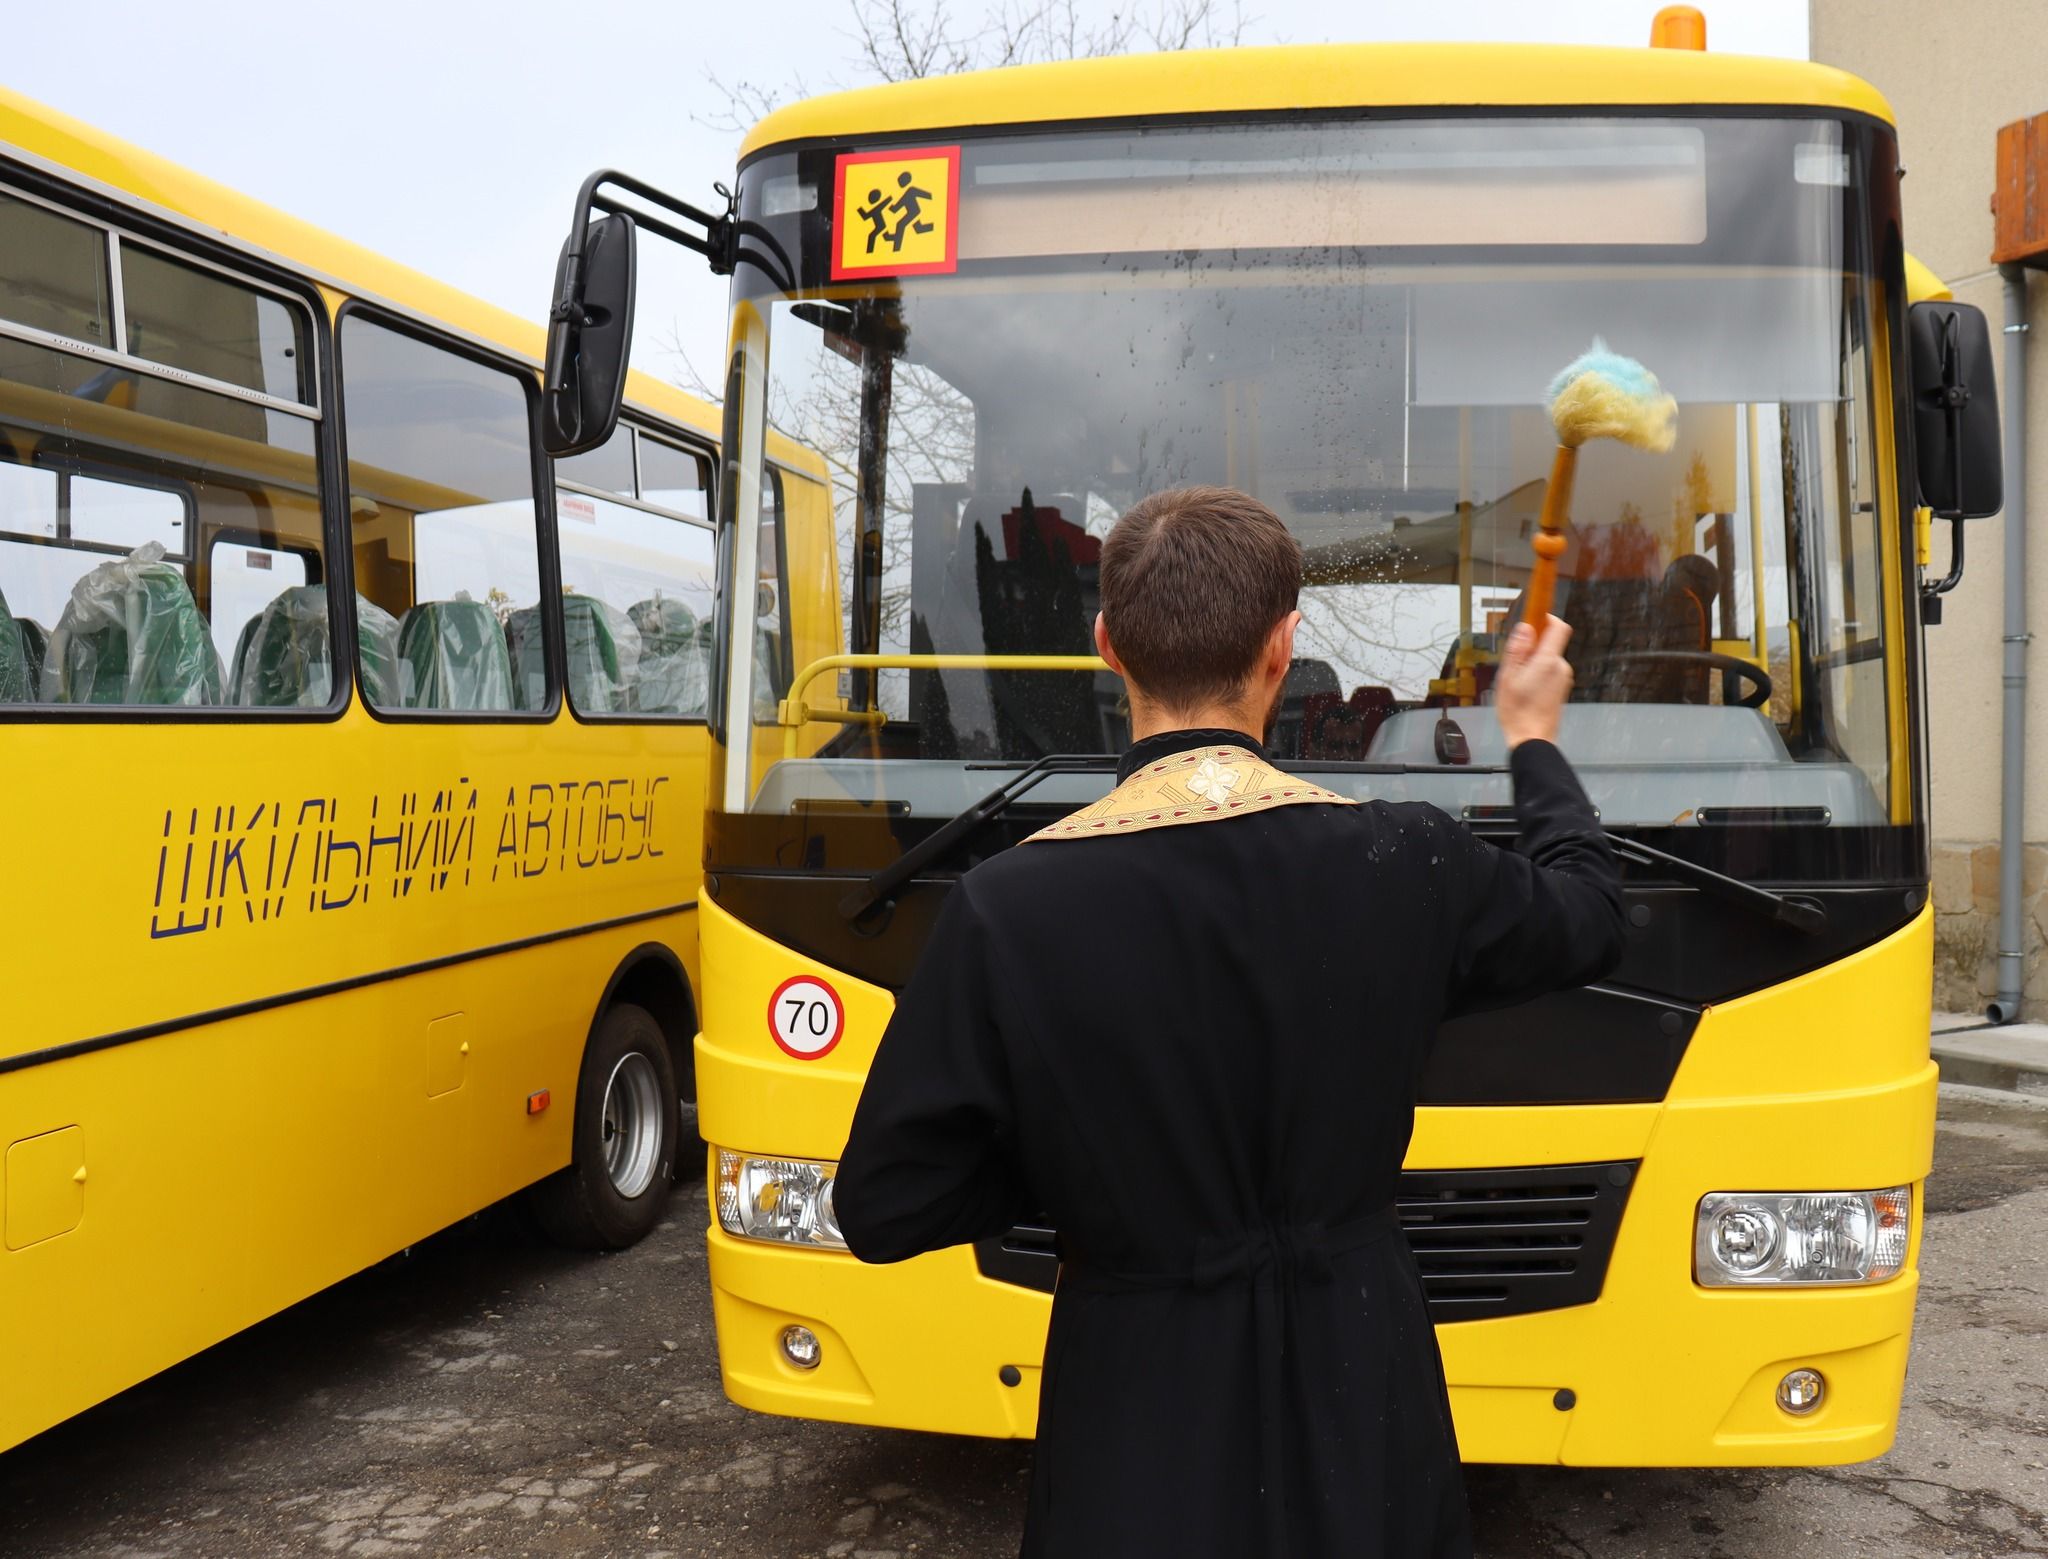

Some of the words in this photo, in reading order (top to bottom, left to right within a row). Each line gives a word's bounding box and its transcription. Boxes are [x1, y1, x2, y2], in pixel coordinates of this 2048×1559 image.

[150, 777, 477, 939] ШКІЛЬНИЙ
[491, 776, 670, 883] АВТОБУС
[785, 999, 829, 1036] 70
